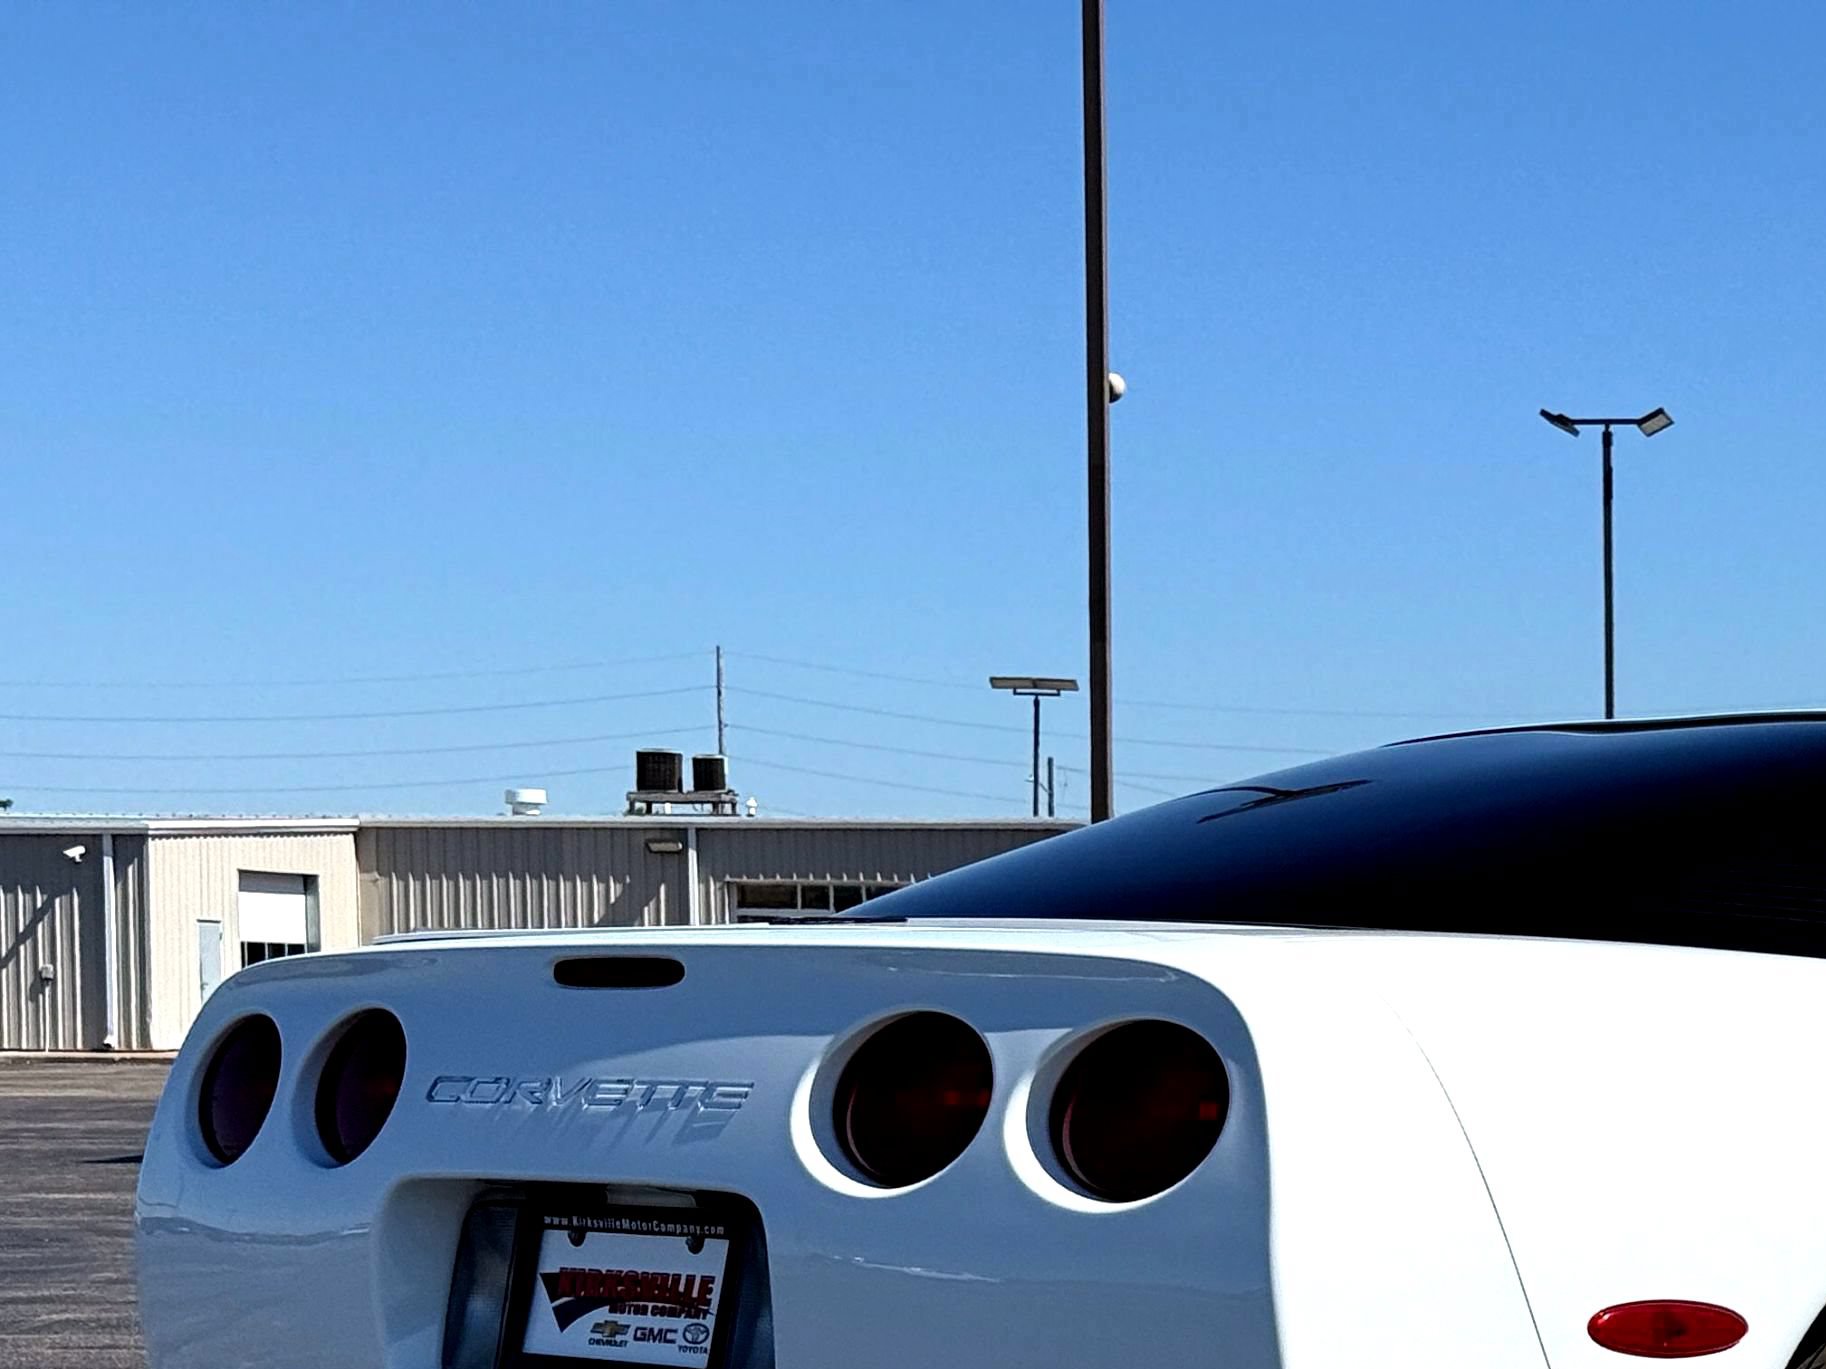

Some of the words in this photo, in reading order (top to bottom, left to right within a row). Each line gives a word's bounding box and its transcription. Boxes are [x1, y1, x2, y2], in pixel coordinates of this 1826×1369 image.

[425, 1075, 754, 1112] CORVETTE
[543, 1215, 725, 1236] www.KirksvilleMotorCompany.com
[650, 1305, 708, 1320] COMPANY
[633, 1327, 678, 1344] GMC
[678, 1345, 708, 1355] TOYOTA
